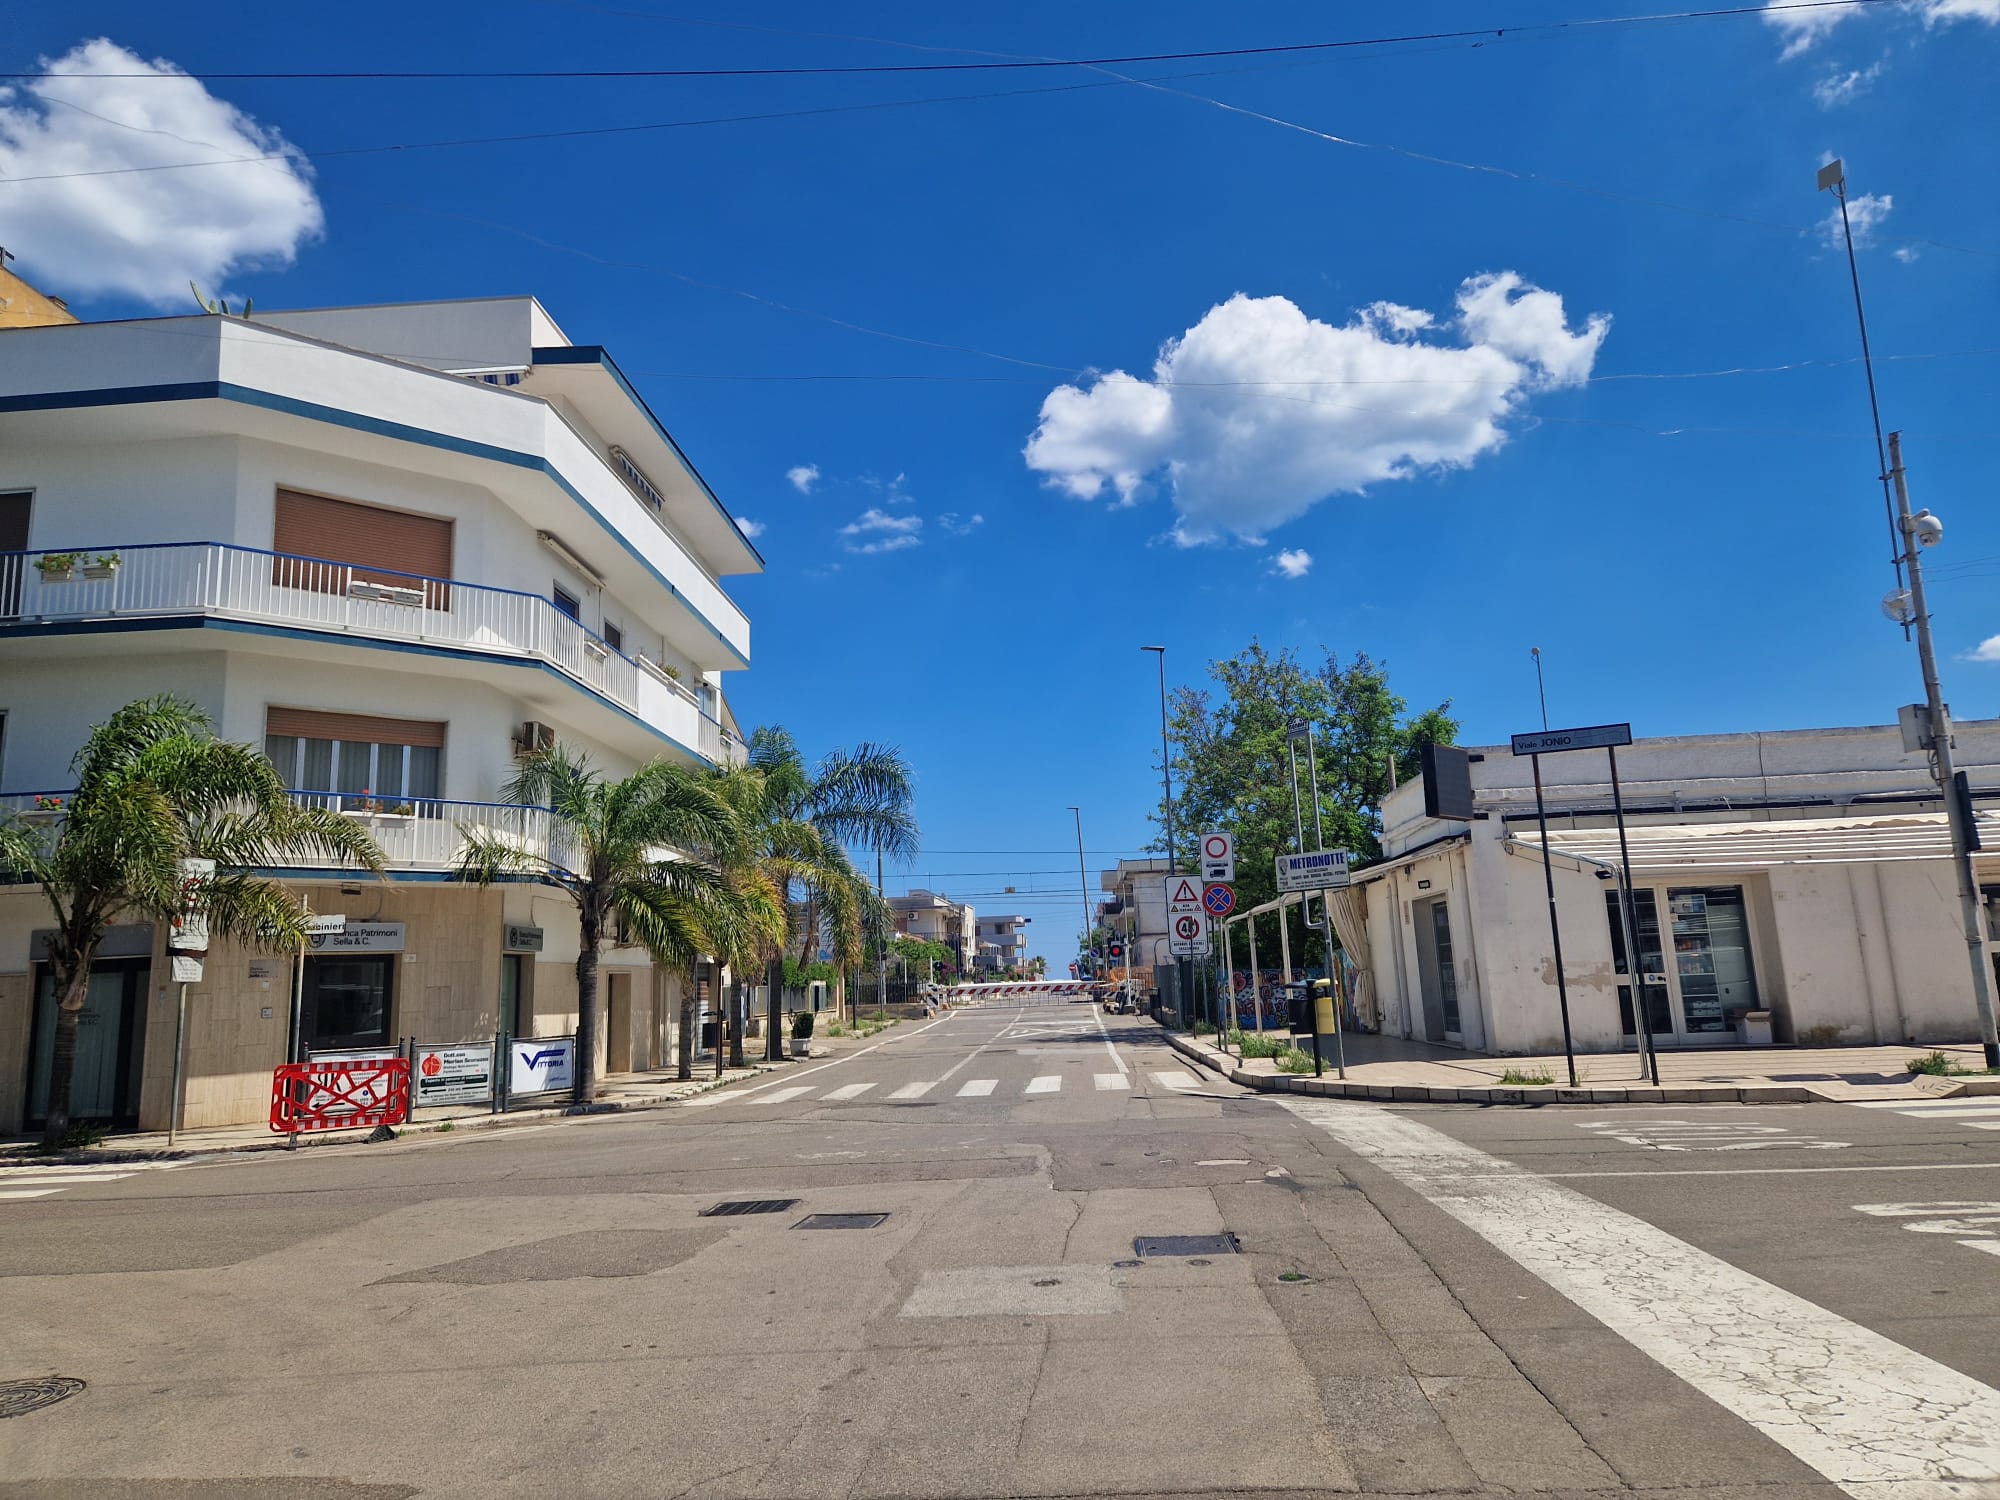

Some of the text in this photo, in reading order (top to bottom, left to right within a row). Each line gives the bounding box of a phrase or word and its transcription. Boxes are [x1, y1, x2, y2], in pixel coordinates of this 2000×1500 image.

[1518, 736, 1572, 750] Viale JONIO
[1289, 852, 1345, 870] METRONOTTE
[360, 928, 398, 937] Patrimoni
[333, 937, 353, 946] Sella
[354, 938, 361, 946] &
